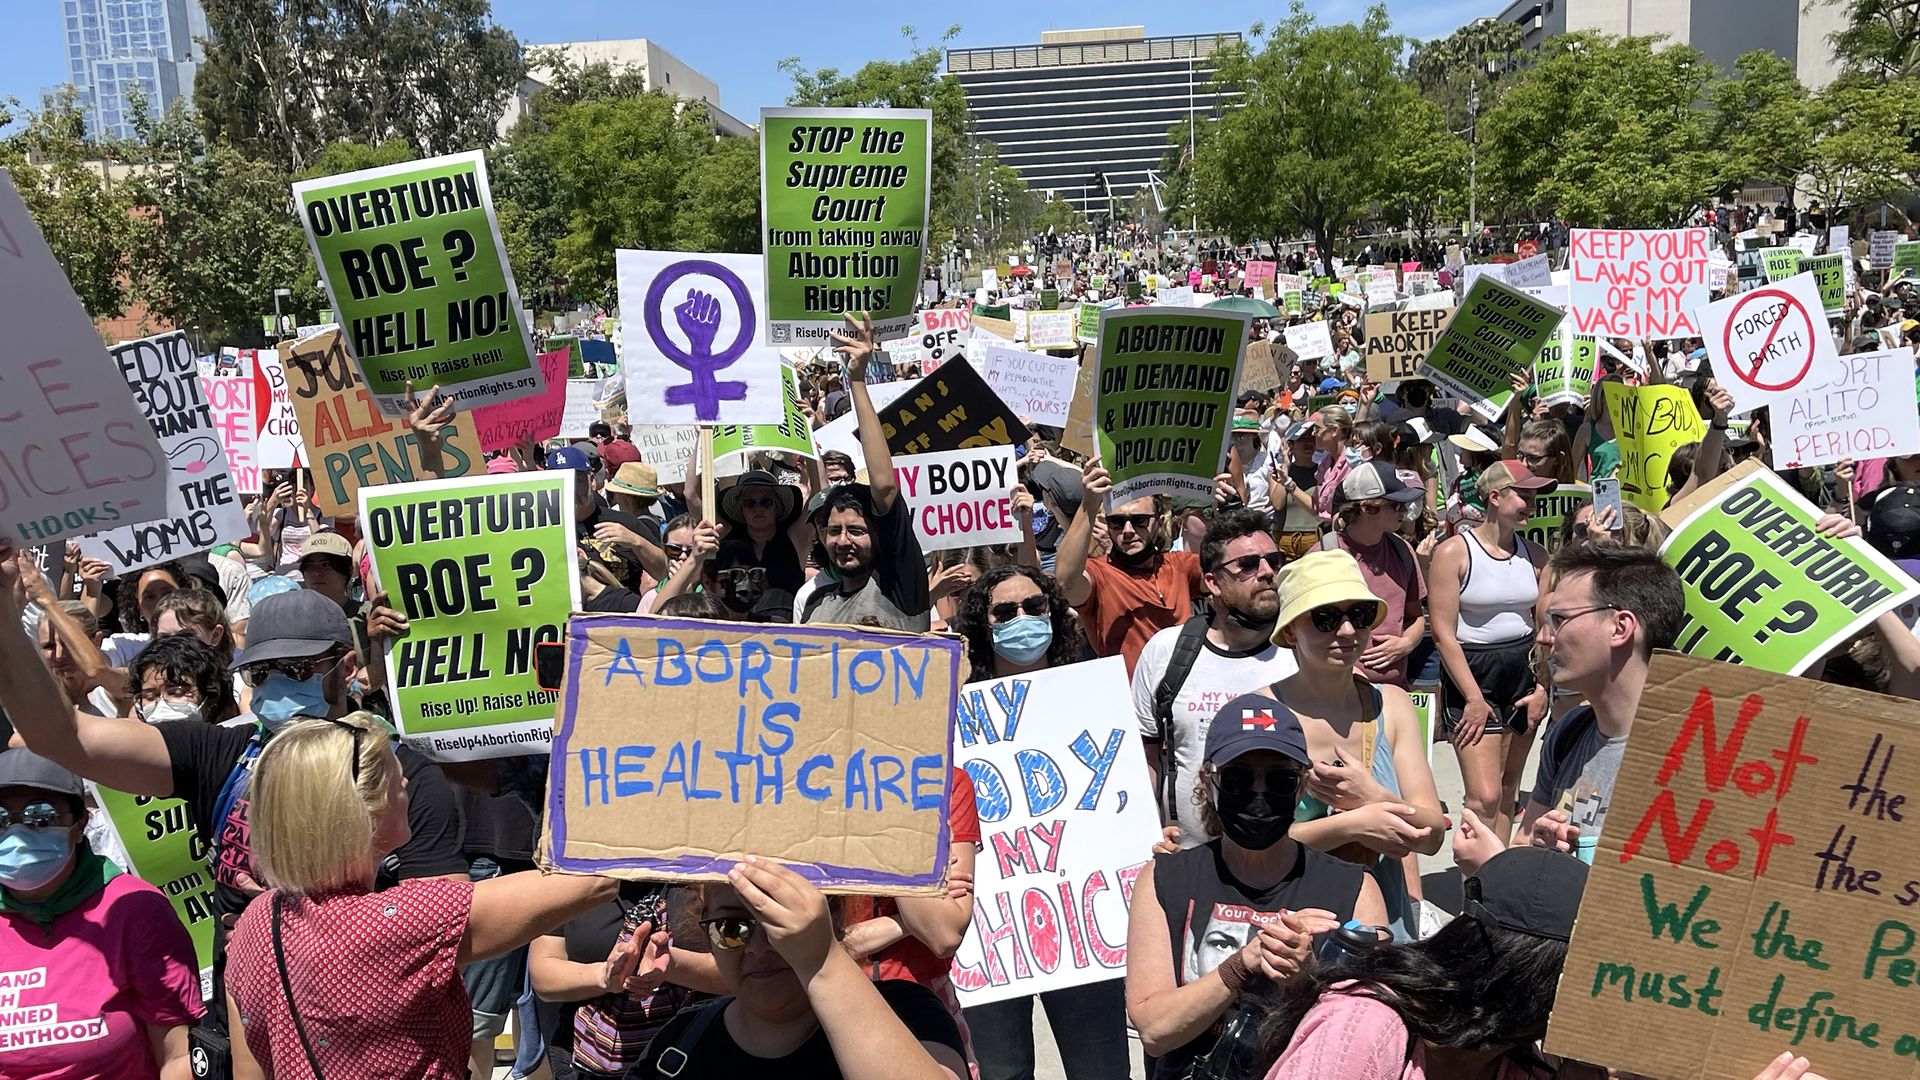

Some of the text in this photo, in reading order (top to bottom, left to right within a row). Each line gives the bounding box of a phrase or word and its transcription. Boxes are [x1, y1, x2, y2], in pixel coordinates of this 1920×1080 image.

[789, 126, 905, 155] STOP the
[786, 161, 909, 192] Supreme
[307, 171, 481, 237] OVERTURN
[811, 195, 887, 223] Court
[769, 228, 922, 249] from taking away
[1570, 228, 1708, 261] KEEP YOUR
[339, 229, 476, 300] ROE ?
[788, 252, 899, 280] Abortion
[1574, 258, 1710, 288] LAWS OUT
[1770, 259, 1792, 271] ROE
[1799, 257, 1843, 271] OVERTURN
[1832, 271, 1840, 285] ?
[804, 285, 893, 314] Rights!
[1481, 288, 1546, 323] STOP the
[1607, 286, 1688, 313] OF MY
[352, 291, 511, 358] HELL NO!
[924, 309, 969, 332] BANS
[1391, 309, 1448, 333] KEEP
[1472, 302, 1538, 340] Supreme
[1734, 302, 1790, 341] FORCED
[922, 329, 958, 349] OFF
[1115, 325, 1226, 355] ABORTION
[1470, 336, 1502, 362] taking
[1474, 324, 1518, 352] Court
[1541, 345, 1563, 364] RO
[1747, 332, 1803, 371] BIRTH
[112, 332, 192, 385] ED TO
[379, 348, 505, 384] Rise Up! Raise Hell!
[991, 355, 1067, 376] IF YOU CUT OFF
[1447, 341, 1509, 380] Abortion
[1572, 366, 1593, 383] NO!
[987, 368, 1000, 383] MY
[1101, 363, 1231, 395] ON DEMAND
[1445, 358, 1497, 394] Rights!
[273, 389, 286, 403] MY
[882, 379, 950, 441] BANS
[1025, 399, 1068, 415] YOURS?
[1030, 388, 1049, 399] CAN
[1788, 387, 1879, 425] ALITO
[149, 404, 213, 440] HANT
[212, 412, 250, 448] HE
[268, 418, 300, 436] CHO
[895, 404, 969, 457] FF MY
[1104, 400, 1220, 434] & WITHOUT
[1621, 399, 1638, 432] MY
[643, 433, 668, 448] FULL
[743, 424, 755, 446] way
[1793, 426, 1896, 463] PERIOD.
[0, 421, 157, 513] ICES
[224, 449, 250, 467] I-
[646, 450, 673, 465] FULL
[1115, 436, 1202, 473] APOLOGY
[179, 473, 233, 511] THE
[231, 466, 259, 492] HY
[927, 457, 1010, 496] BODY
[16, 500, 121, 541] HOOKS
[369, 488, 562, 549] OVERTURN
[921, 498, 1013, 537] CHOICE
[103, 511, 218, 568] WOMB
[1719, 486, 1895, 616] OVERTURN
[396, 547, 546, 621] ROE ?
[1675, 528, 1783, 625] ROE
[1752, 600, 1819, 646] ?
[397, 633, 491, 689] HELL
[595, 637, 931, 706] ABORTION
[421, 701, 452, 718] Rise
[456, 694, 479, 716] Up!
[483, 692, 523, 712] Raise
[1188, 702, 1220, 713] DATE
[1202, 691, 1221, 702] MY
[1407, 693, 1429, 708] ay
[735, 702, 801, 757] IS
[957, 679, 1032, 748] MY
[1654, 685, 1906, 822] Not the
[580, 739, 944, 813] HEALTHCARE
[963, 728, 1128, 823] ODY,
[990, 819, 1067, 879] MY
[1620, 789, 1796, 881] Not
[1814, 824, 1882, 896] the
[159, 873, 203, 897] rom
[1216, 903, 1247, 919] Your
[1640, 873, 1920, 987] We the Pe
[0, 971, 42, 989] AND
[0, 1008, 54, 1025] NNED
[1591, 962, 1881, 1047] must define
[0, 1022, 102, 1048] ENTHOOD
